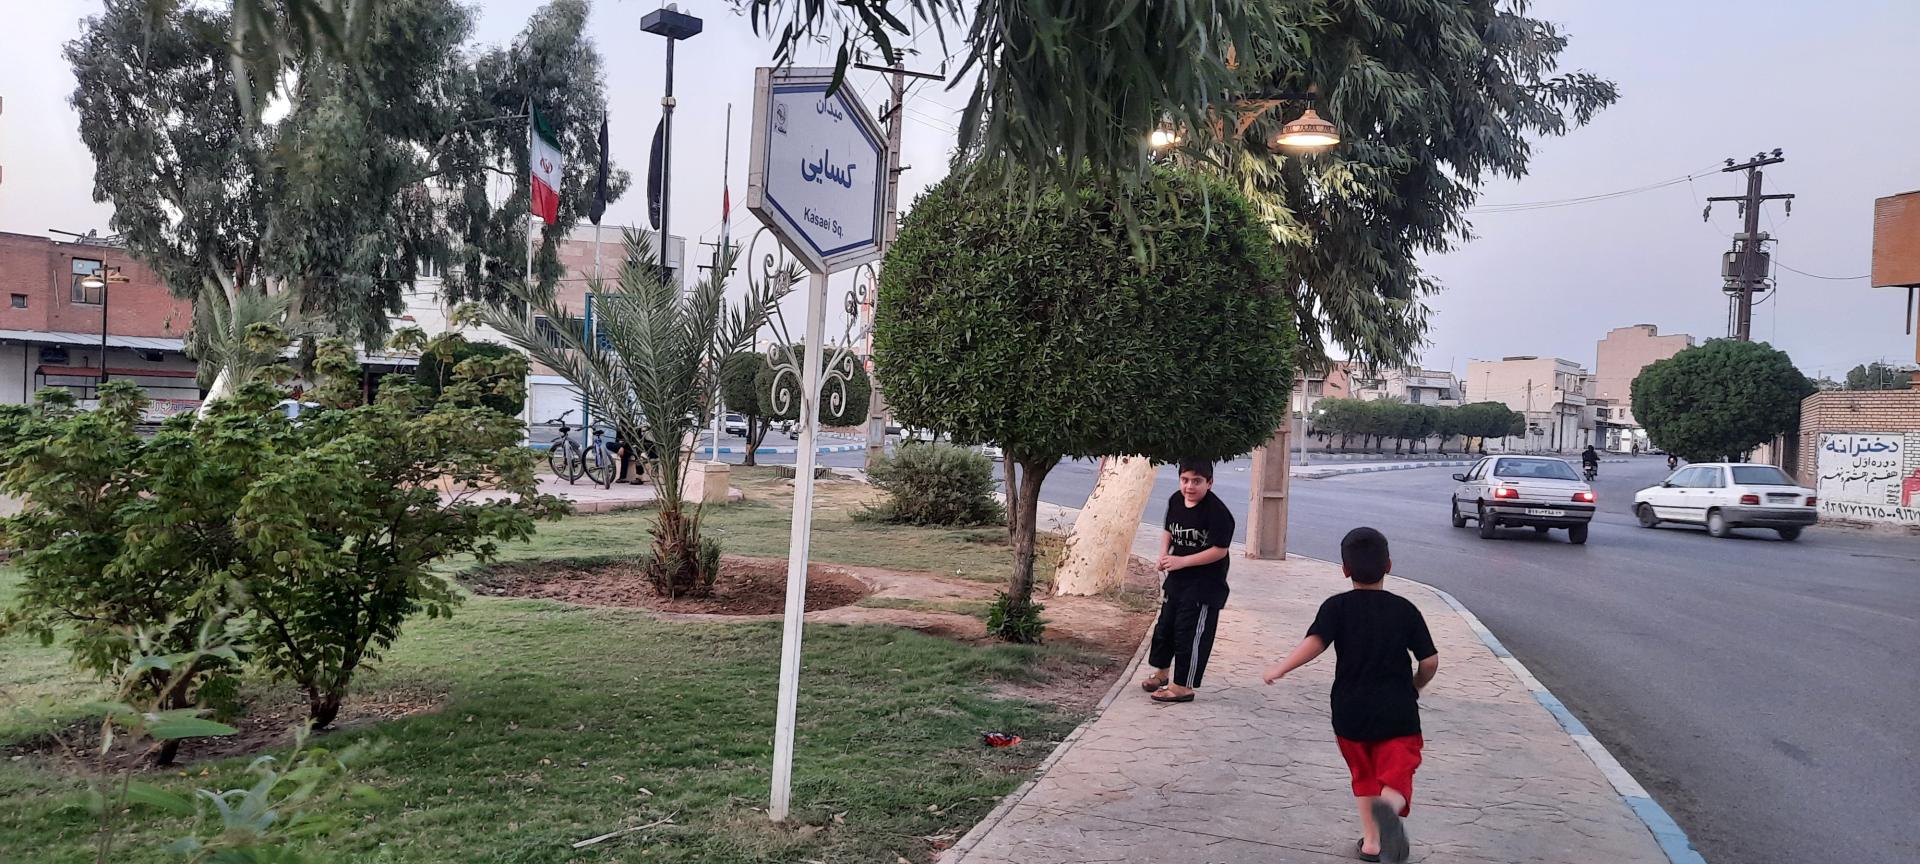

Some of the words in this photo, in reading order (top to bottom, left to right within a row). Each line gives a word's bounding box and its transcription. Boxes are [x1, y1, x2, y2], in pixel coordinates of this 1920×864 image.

[816, 98, 843, 122] میدان
[801, 149, 856, 189] کسایی
[832, 219, 844, 239] Sq.
[1826, 437, 1899, 457] دخترانه
[1871, 460, 1896, 468] دوره
